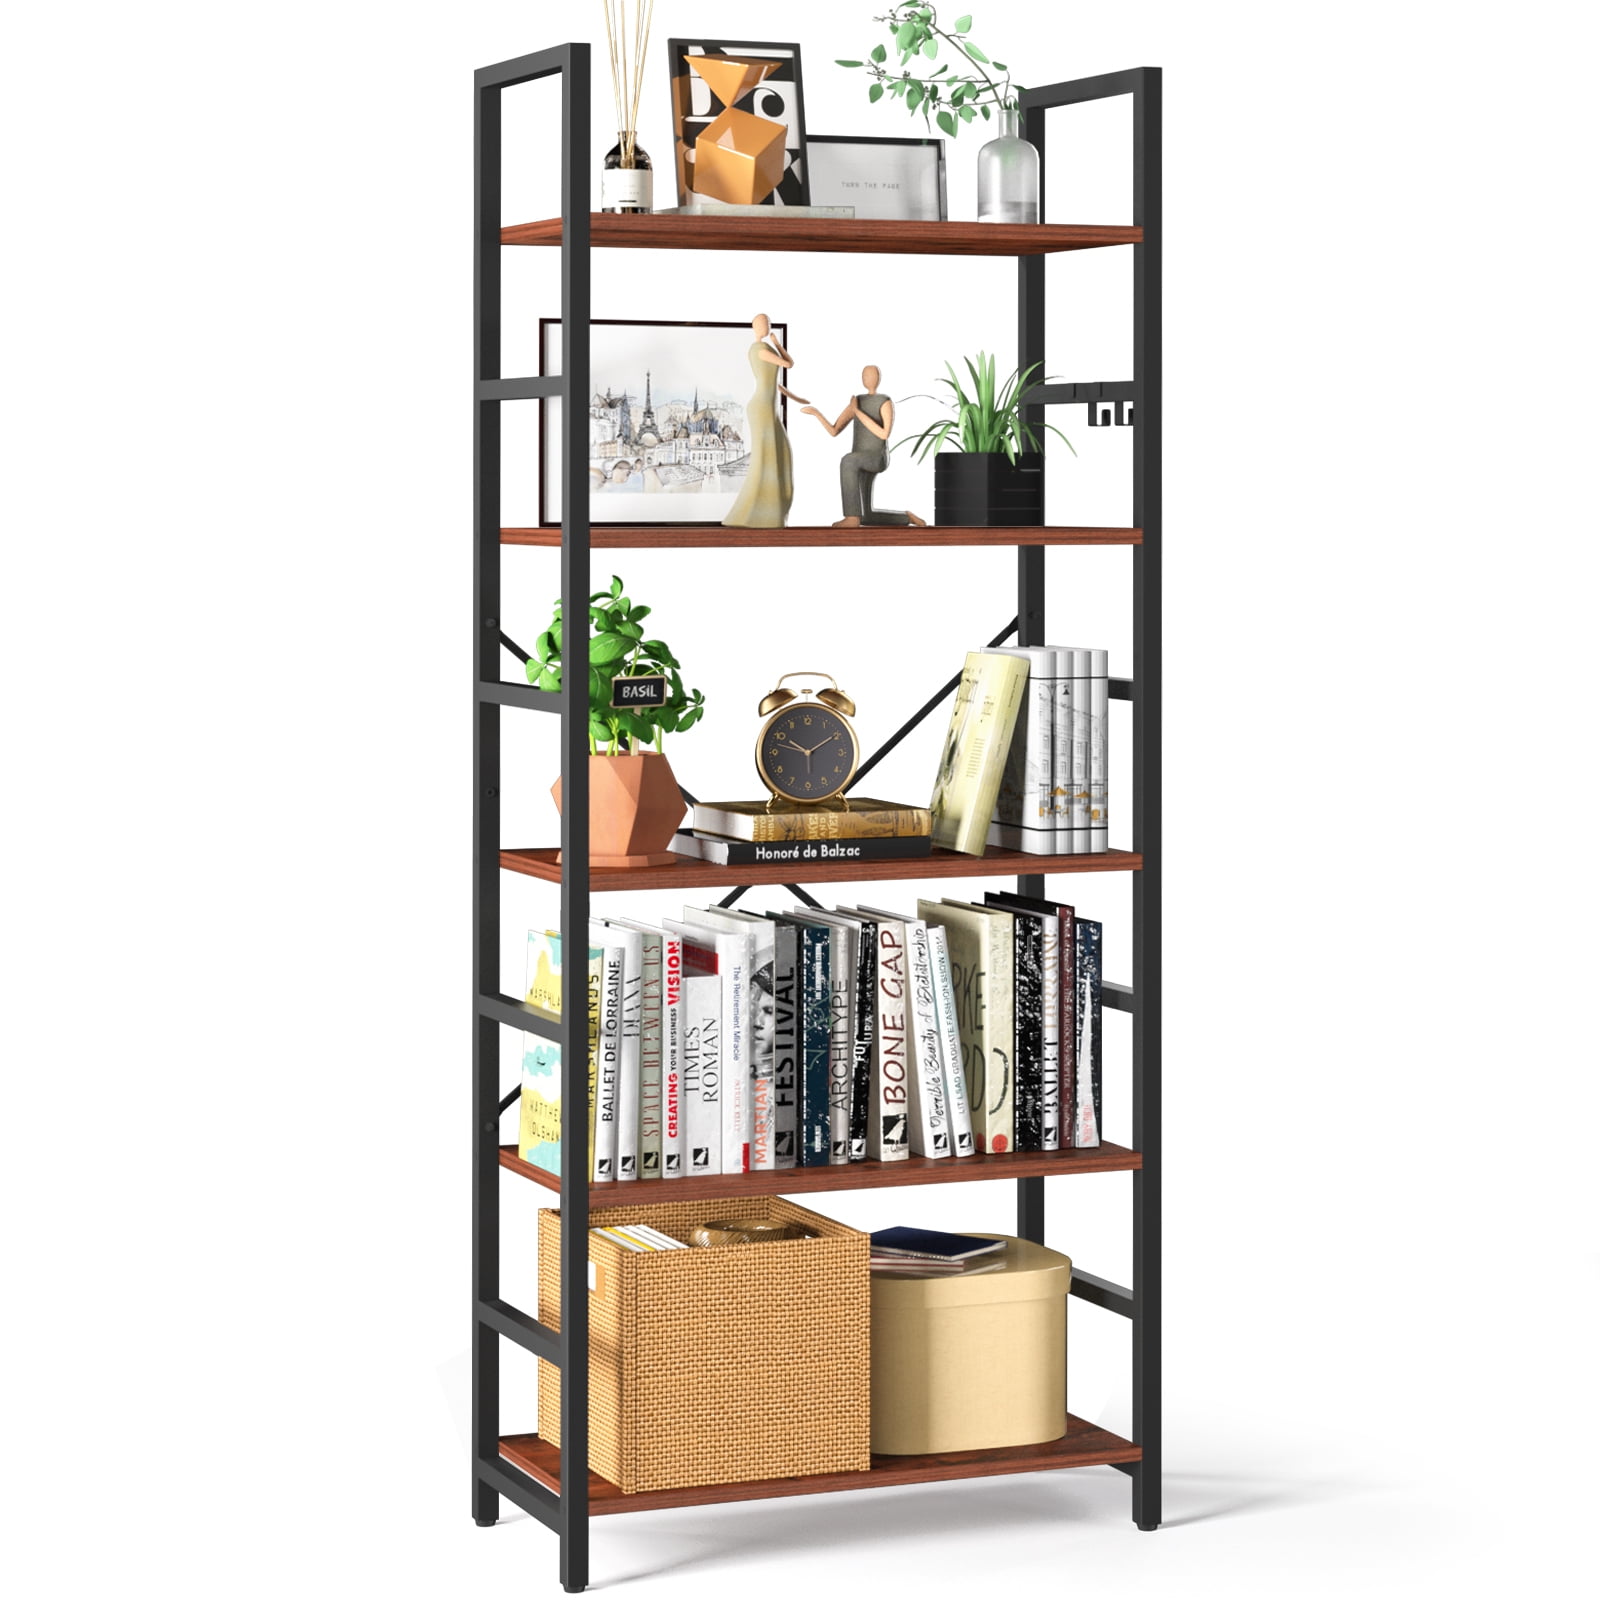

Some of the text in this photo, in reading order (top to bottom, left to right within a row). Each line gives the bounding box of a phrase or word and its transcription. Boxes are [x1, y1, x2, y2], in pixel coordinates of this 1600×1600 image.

[756, 843, 860, 860] Honoré de Balzac
[667, 940, 681, 1006] VISION
[732, 966, 742, 1061] The Retirement Miracle
[602, 959, 621, 1122] BALLET DE LORRAINE
[643, 978, 660, 1069] BETWEEN
[703, 1017, 719, 1102] ROMAN
[776, 967, 795, 1107] FESTIVAL
[831, 980, 849, 1112] ARCHITYPE
[880, 929, 907, 1105] BONE GAP
[947, 1026, 961, 1076] GRADUATE
[684, 1026, 700, 1097] TIMES
[643, 1079, 660, 1137] SPACE
[668, 1072, 679, 1138] CREATING
[753, 1078, 768, 1164] MARTIAN
